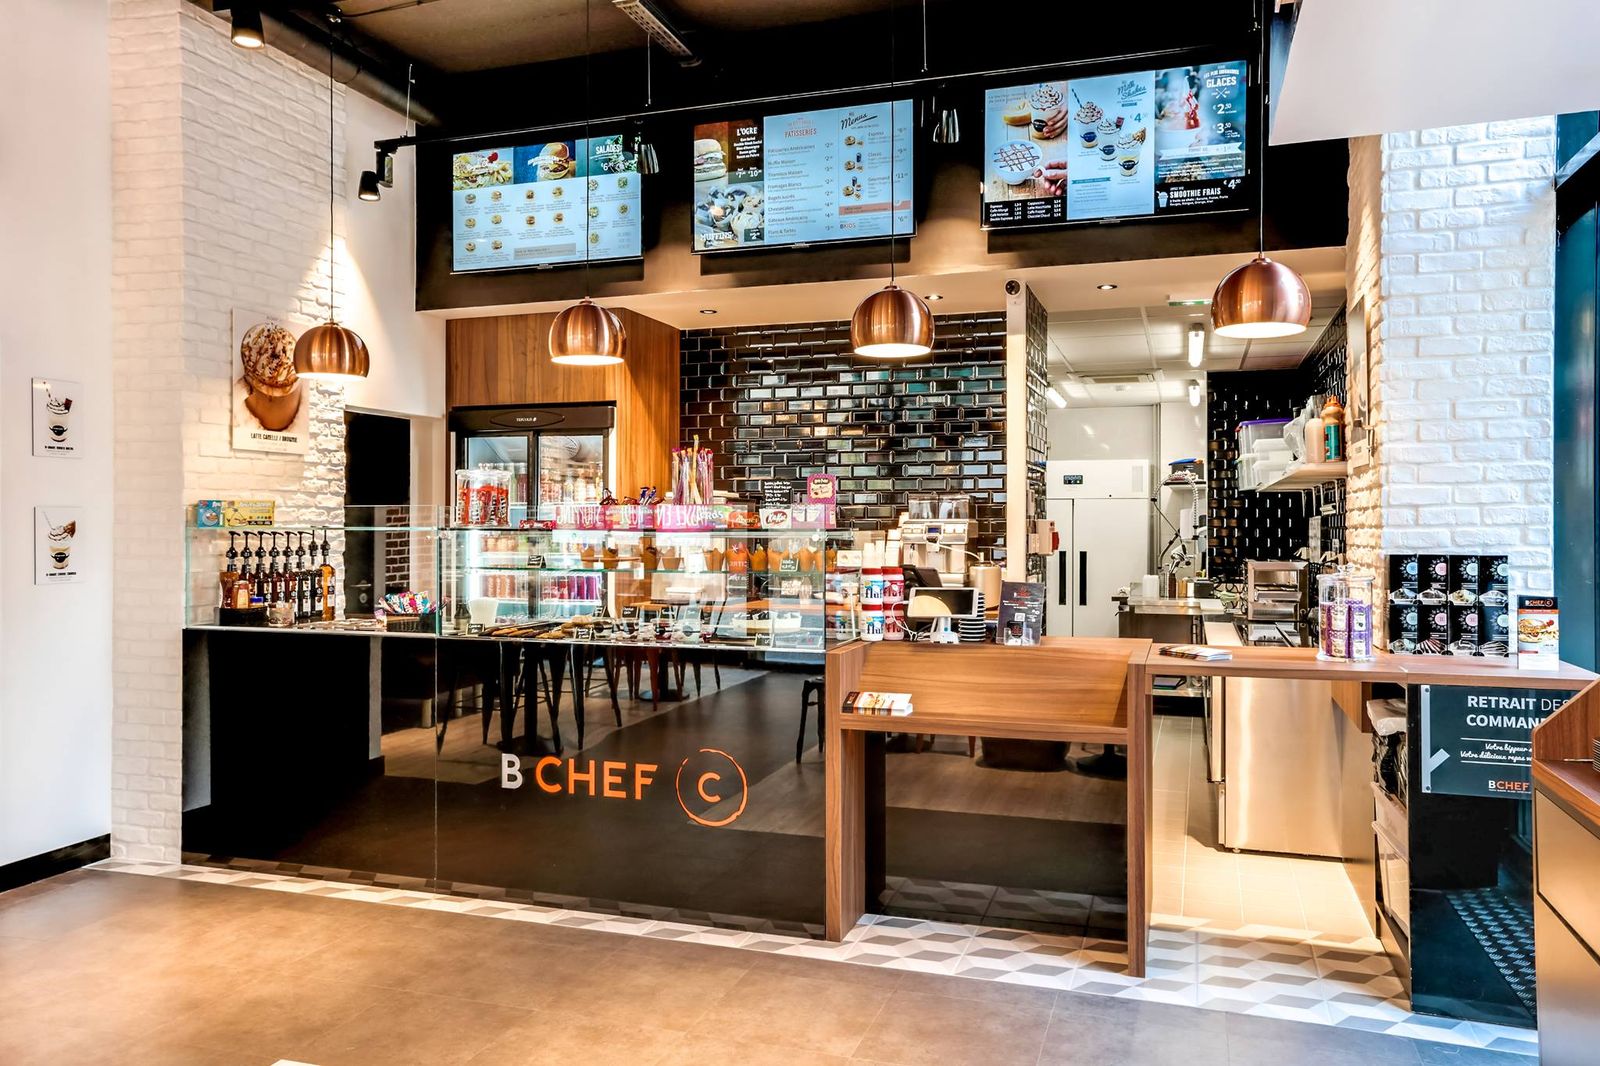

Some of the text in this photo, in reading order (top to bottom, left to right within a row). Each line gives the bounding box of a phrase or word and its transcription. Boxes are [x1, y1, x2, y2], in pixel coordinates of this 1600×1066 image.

[1206, 76, 1236, 88] GLACES
[736, 127, 758, 136] L'OGRE
[1170, 188, 1221, 198] SMOOTHIE FRAIS
[1467, 695, 1537, 710] RETRAIT
[1484, 743, 1504, 751] Votre
[1504, 743, 1528, 754] bippeur
[1478, 752, 1508, 760] délicieux
[1488, 780, 1530, 791] BCHEF
